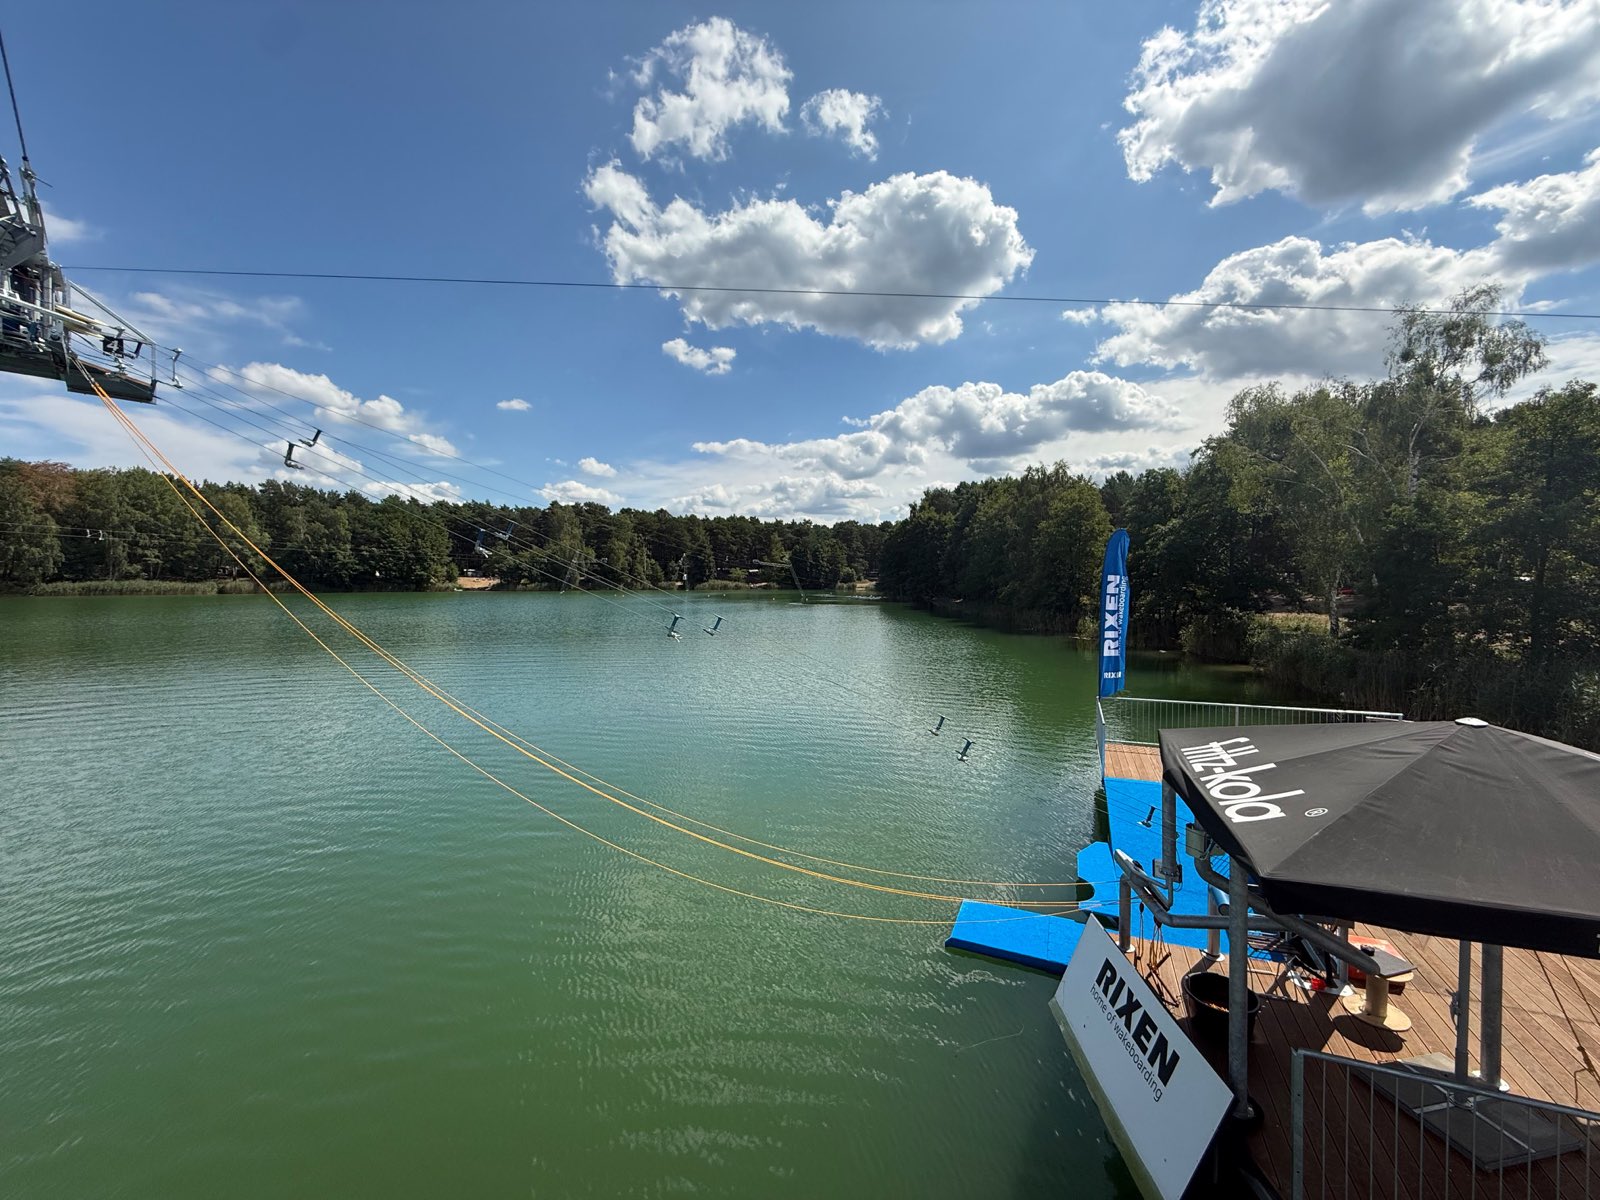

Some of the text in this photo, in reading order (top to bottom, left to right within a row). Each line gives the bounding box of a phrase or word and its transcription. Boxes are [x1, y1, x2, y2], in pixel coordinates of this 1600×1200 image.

[106, 340, 119, 351] 4
[1103, 574, 1120, 656] RIXEN
[1180, 737, 1305, 823] fritz-kola
[1090, 983, 1163, 1103] home of wakeboarding
[1095, 957, 1180, 1087] RIXEN
